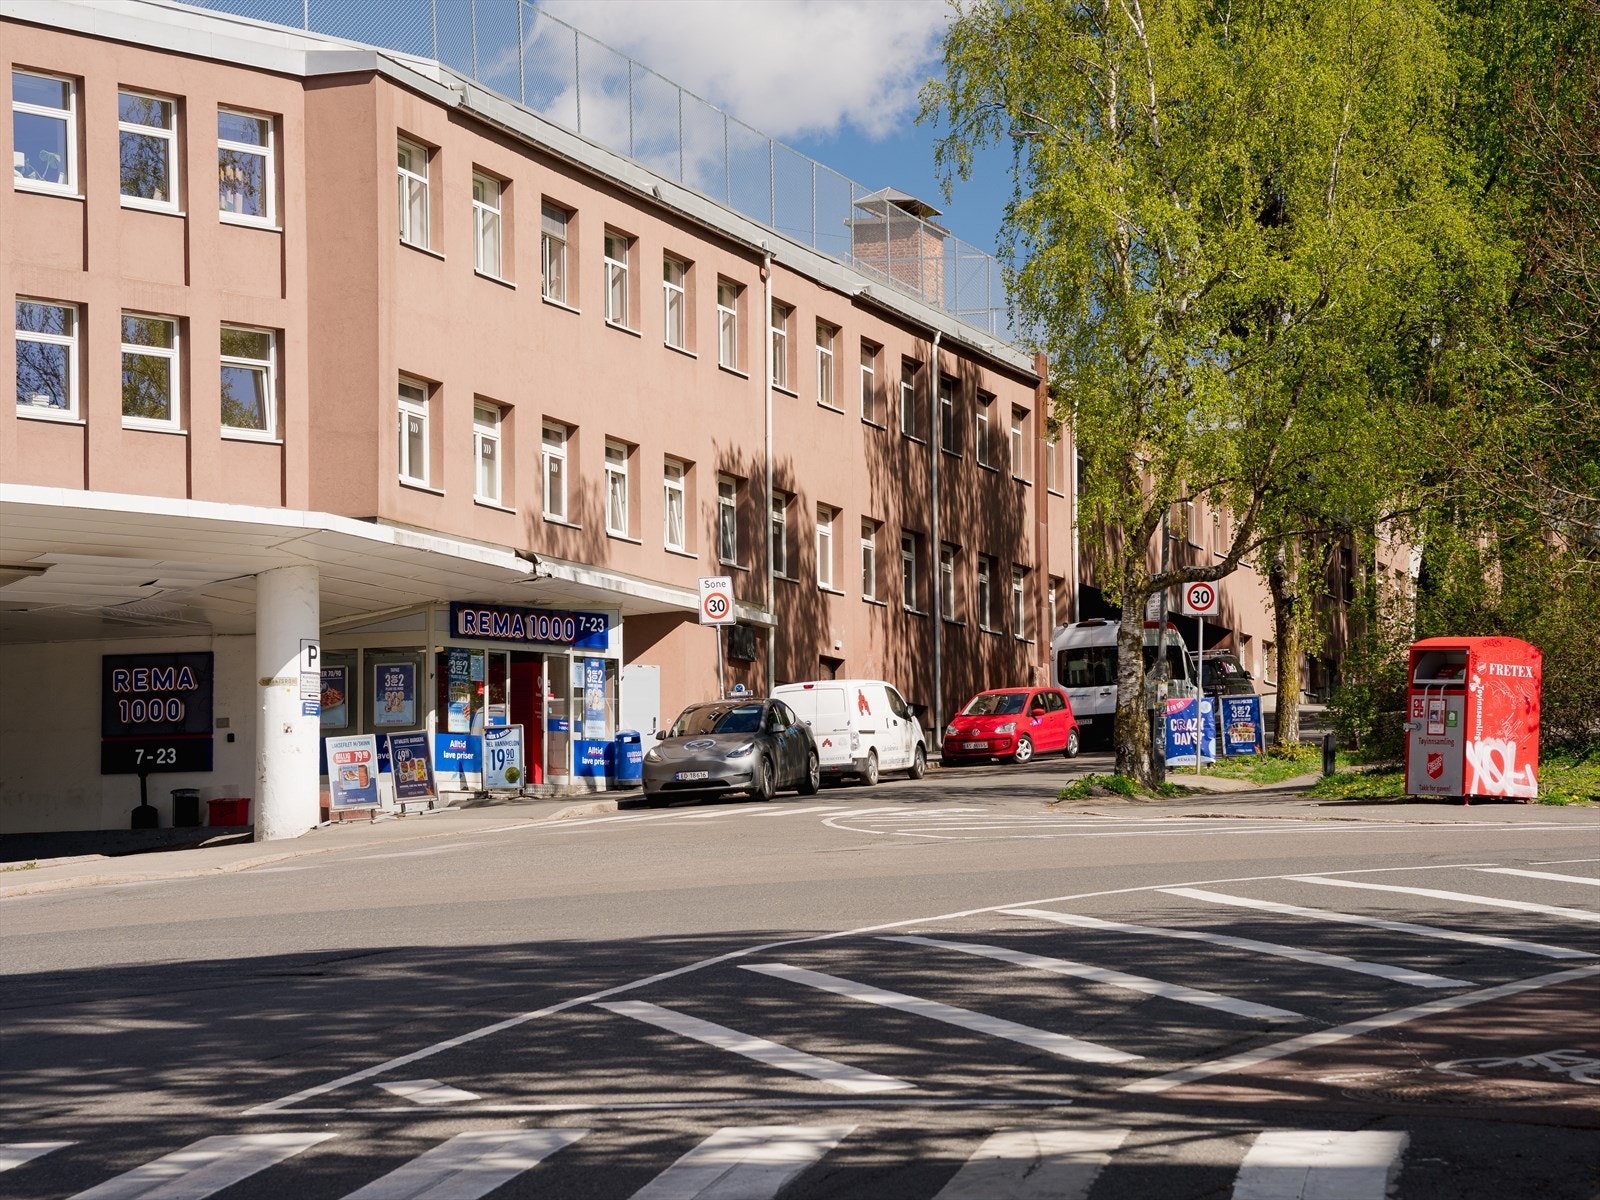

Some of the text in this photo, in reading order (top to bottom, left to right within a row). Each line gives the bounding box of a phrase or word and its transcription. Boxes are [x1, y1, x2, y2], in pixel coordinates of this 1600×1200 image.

[704, 579, 727, 589] Sone
[1193, 590, 1210, 604] 30
[708, 599, 726, 613] 30
[462, 609, 575, 641] REMA 1000
[579, 616, 605, 633] 7-23
[308, 645, 317, 667] P
[1489, 663, 1533, 678] FRETEX
[112, 666, 197, 693] REMA
[118, 698, 185, 723] 1000
[1231, 705, 1238, 718] 3
[1245, 705, 1251, 718] 2
[449, 739, 467, 749] Alltid
[1418, 737, 1455, 747] Tøyinnsamling
[135, 747, 177, 765] 7-23
[354, 751, 363, 762] 79
[376, 752, 390, 760] ave
[443, 750, 474, 761] lave priser
[588, 746, 604, 754] Alltid
[490, 748, 515, 771] 19 90
[582, 756, 610, 766] lave priser
